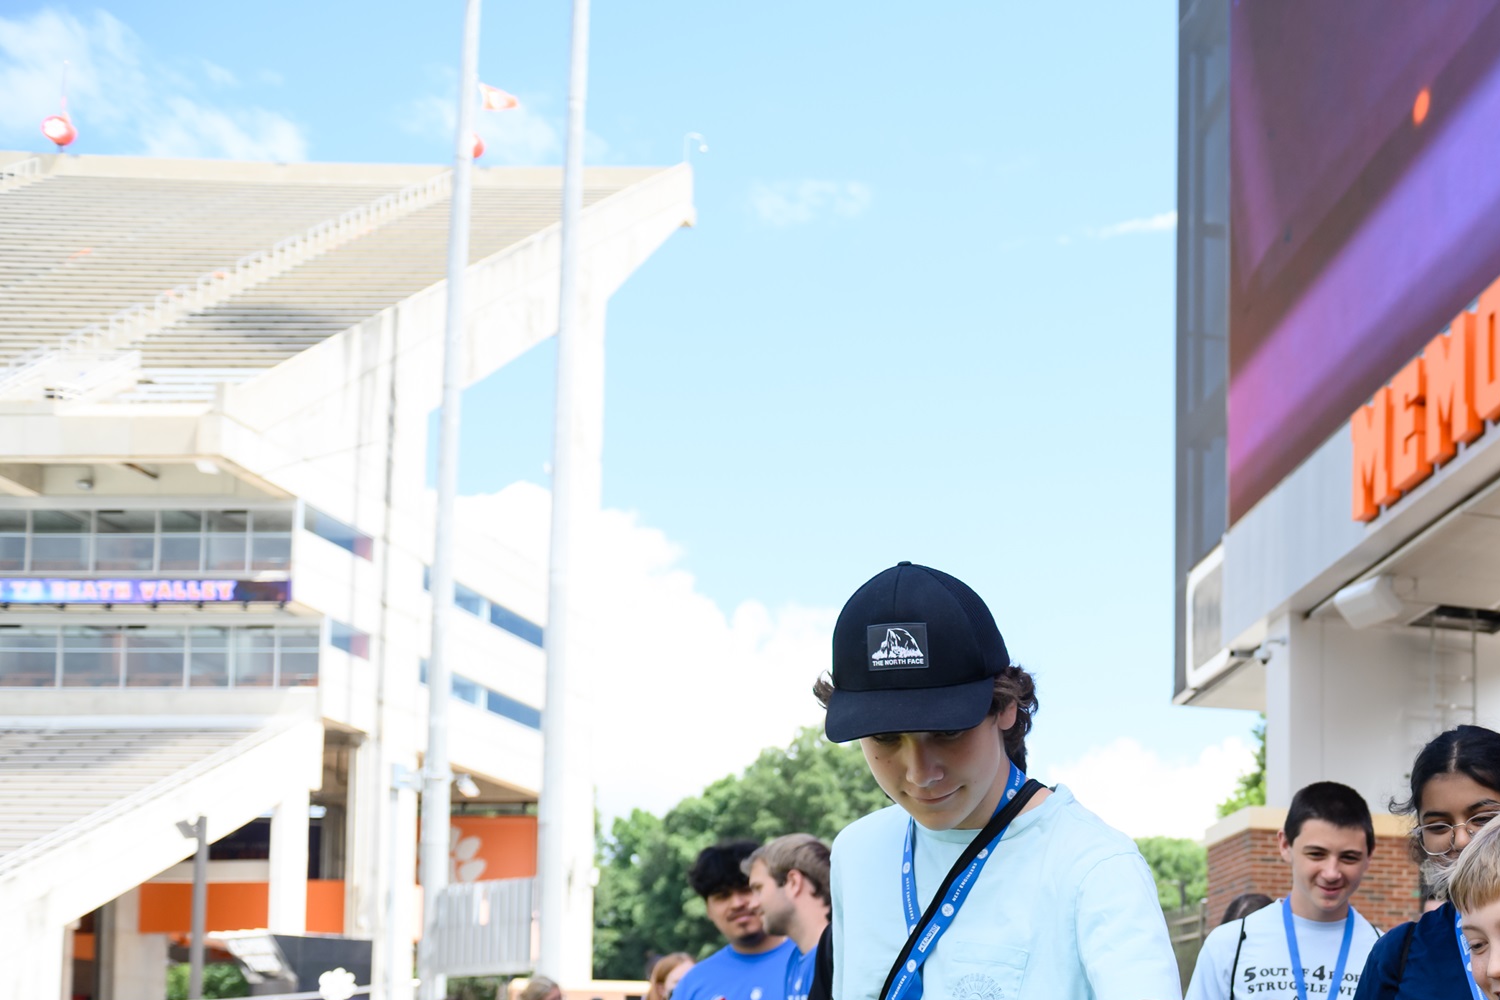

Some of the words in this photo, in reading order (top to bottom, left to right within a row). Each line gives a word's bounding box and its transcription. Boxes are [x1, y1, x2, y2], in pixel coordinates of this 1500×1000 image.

[139, 580, 237, 600] VALLEY
[959, 862, 978, 889] ENGINEERS
[1244, 966, 1256, 983] 5
[1260, 967, 1289, 977] OUT
[1312, 965, 1326, 981] 4
